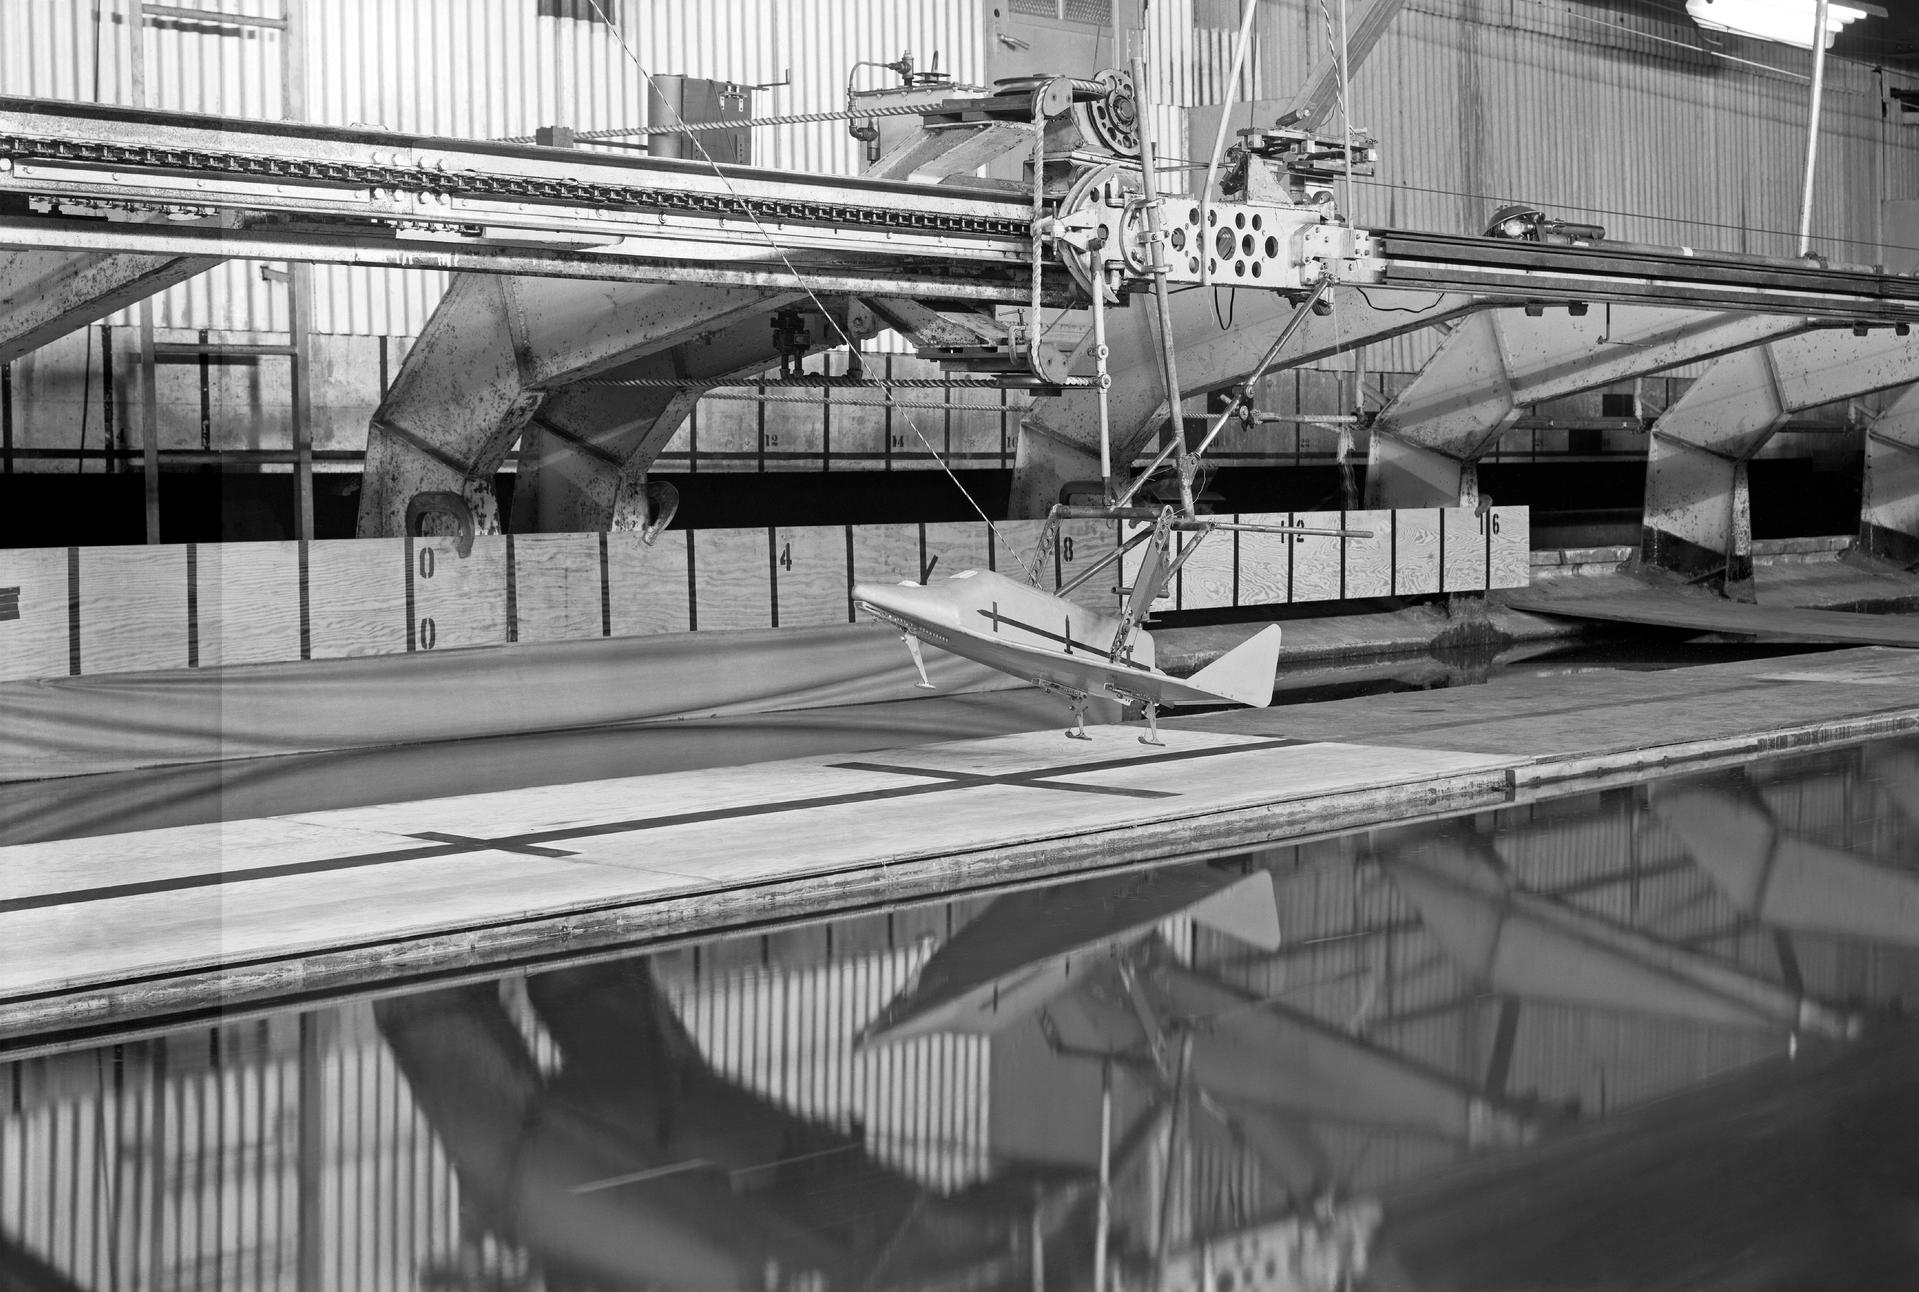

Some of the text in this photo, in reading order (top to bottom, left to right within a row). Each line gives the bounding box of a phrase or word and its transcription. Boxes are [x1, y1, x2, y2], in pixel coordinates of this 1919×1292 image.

[766, 434, 778, 446] 12
[1479, 513, 1500, 535] 16
[419, 547, 434, 579] 0
[780, 542, 792, 572] 4
[1063, 536, 1073, 562] 8
[420, 617, 436, 650] 0
